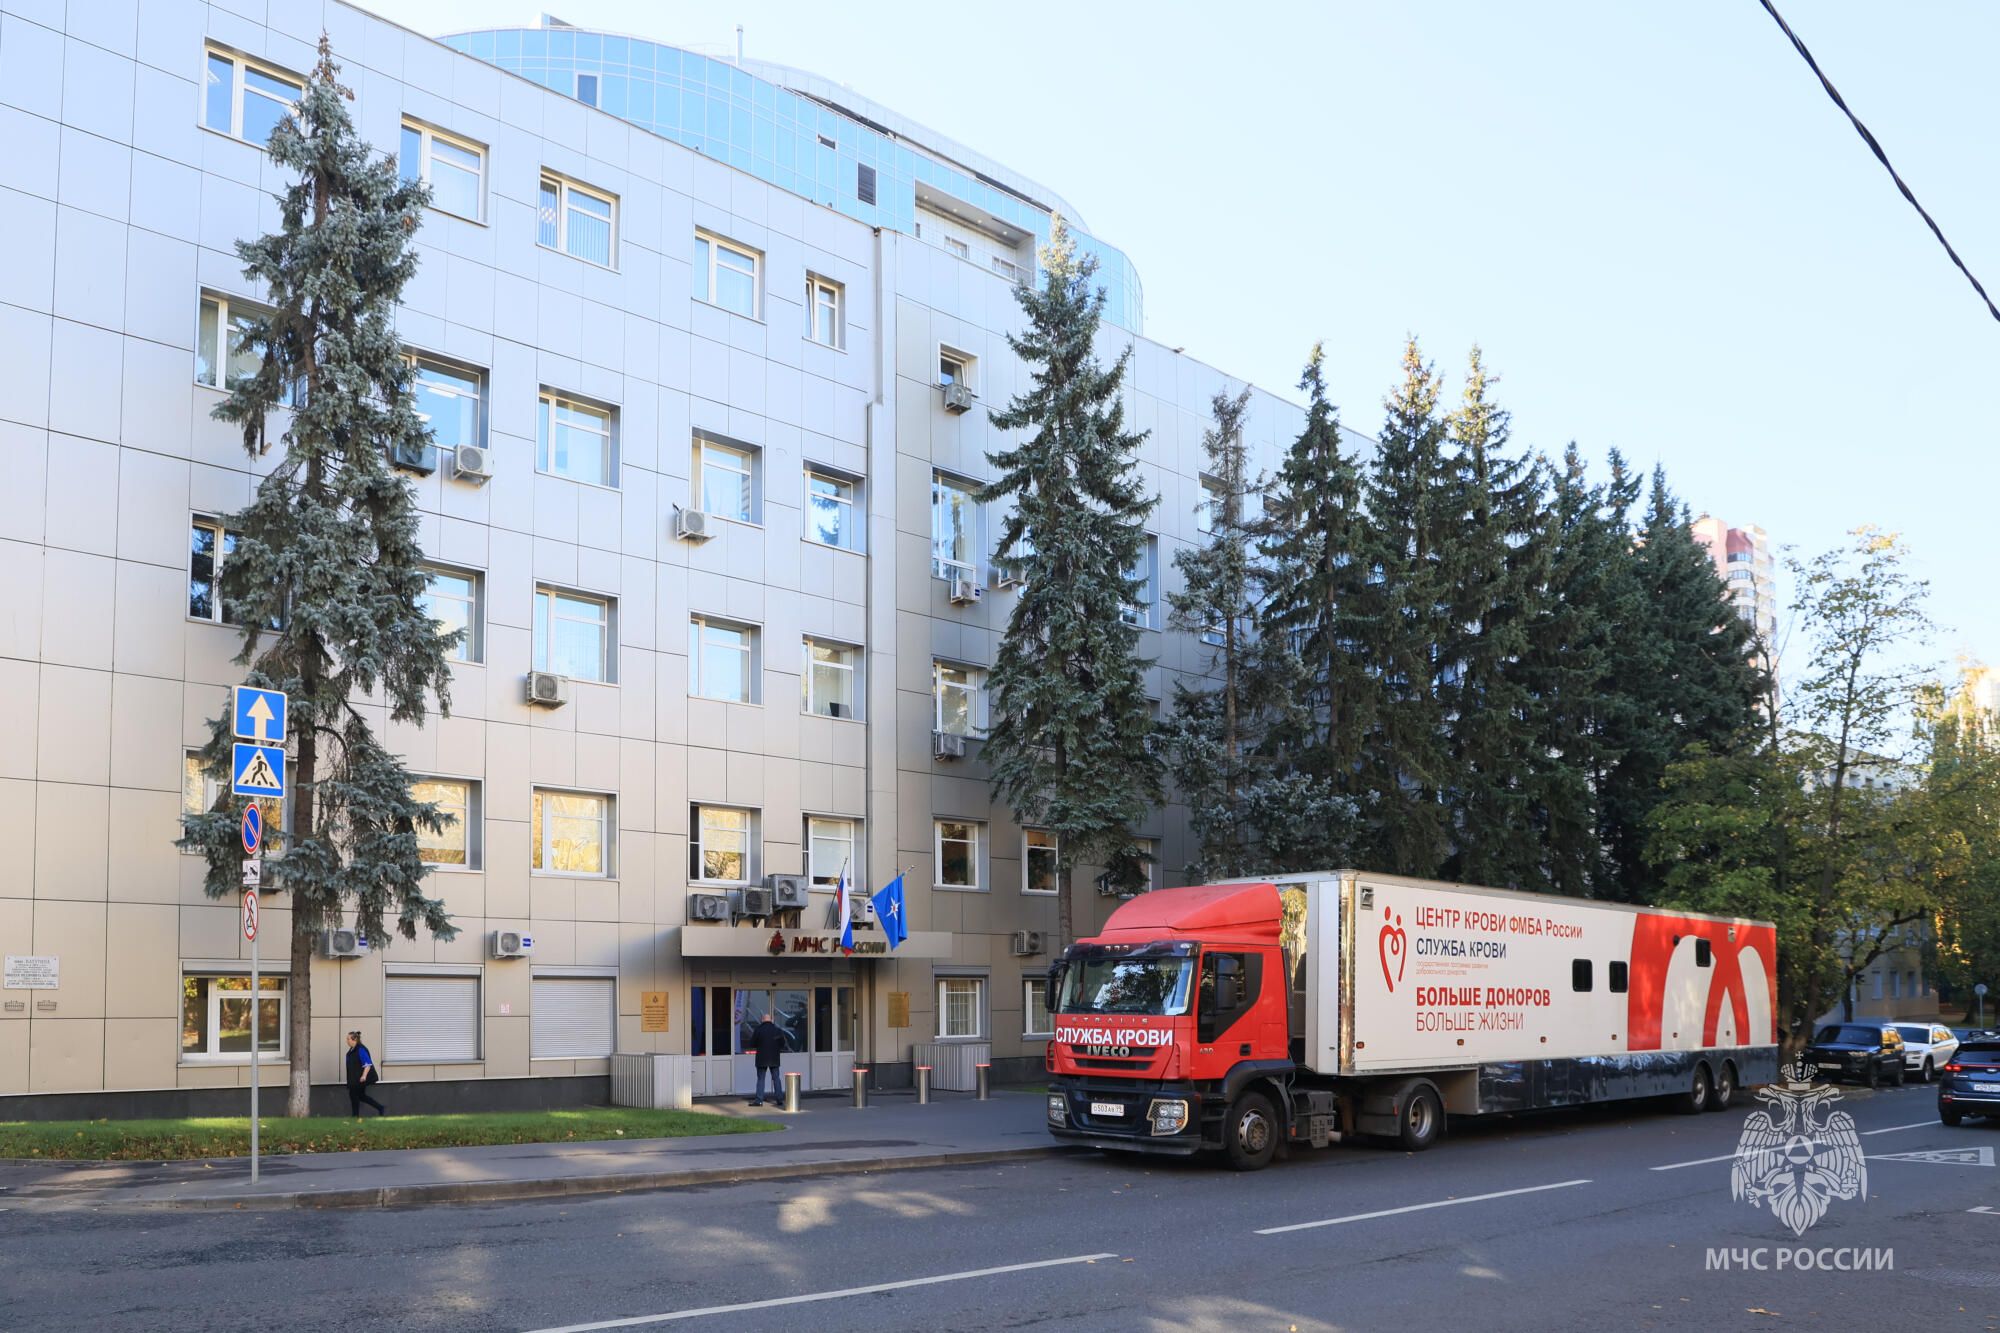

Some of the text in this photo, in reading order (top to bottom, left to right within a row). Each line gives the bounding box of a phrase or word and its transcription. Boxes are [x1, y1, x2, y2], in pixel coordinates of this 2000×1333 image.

[1416, 906, 1583, 938] ЦЕНТР КРОВИ ФМБА России
[792, 936, 829, 953] МЧС
[1416, 937, 1507, 958] СЛУЖБА КРОВИ
[1416, 987, 1551, 1009] БОЛЬШЕ ДОНОРОВ
[1416, 1012, 1524, 1031] БОЛЬШЕ ЖИЗНИ
[1055, 1027, 1173, 1046] СЛУЖБА КРОВИ
[1086, 1045, 1131, 1057] IVECO
